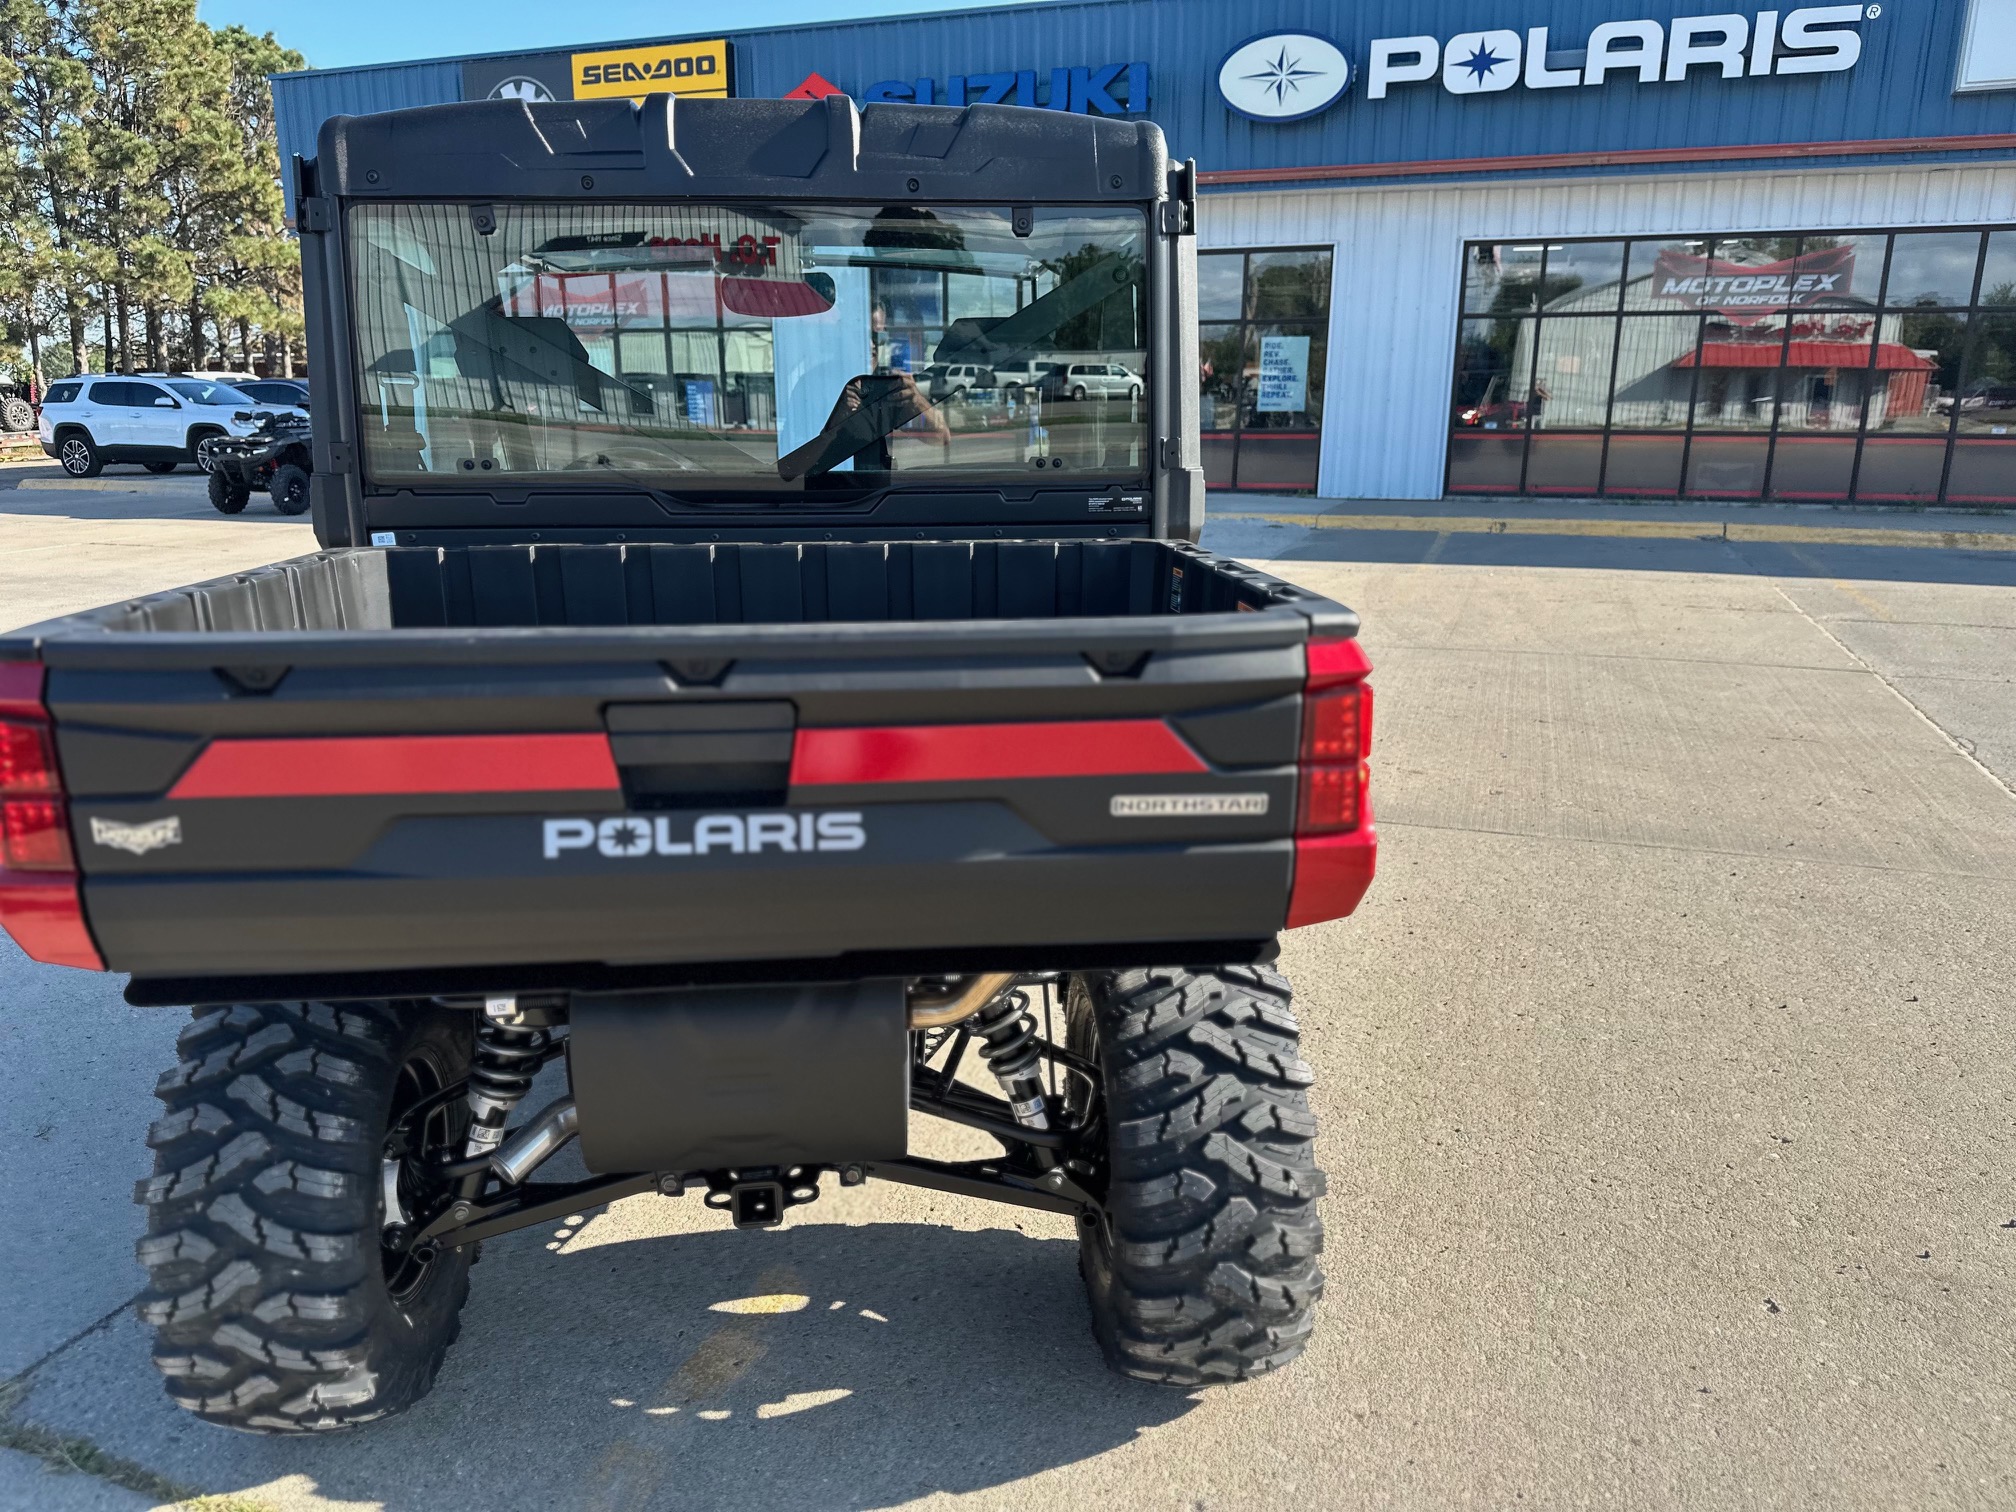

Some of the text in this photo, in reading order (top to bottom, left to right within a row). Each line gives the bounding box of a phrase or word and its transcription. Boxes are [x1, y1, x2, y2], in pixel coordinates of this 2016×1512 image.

[1660, 273, 1842, 295] MOTOPLEX
[1695, 293, 1803, 306] OF NORFOLK
[1119, 799, 1259, 812] NORTHSTAR
[543, 812, 866, 859] POLARIS
